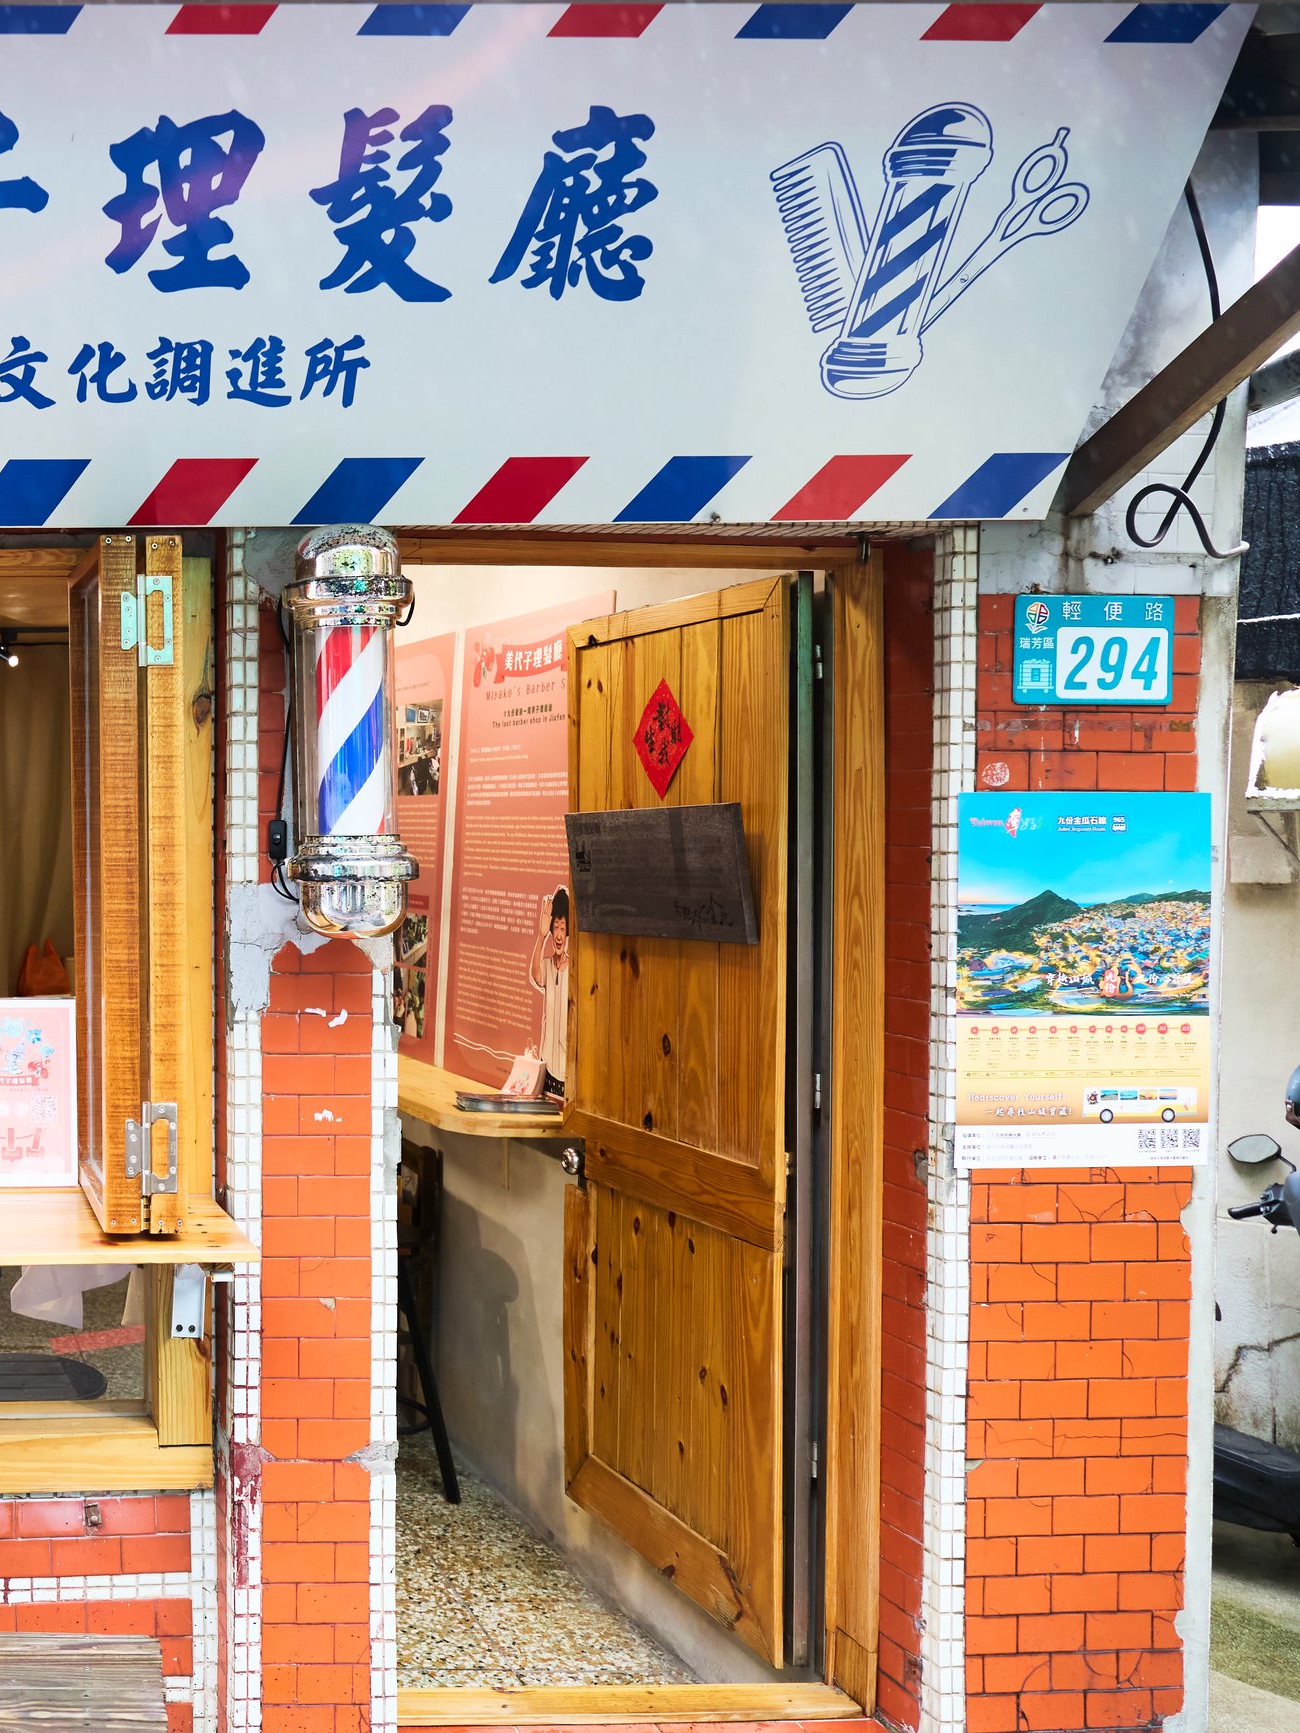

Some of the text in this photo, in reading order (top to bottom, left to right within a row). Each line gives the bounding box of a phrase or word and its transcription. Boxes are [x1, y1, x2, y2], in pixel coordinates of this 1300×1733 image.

[1062, 601, 1164, 621] 輕便路
[1019, 637, 1055, 650] 瑞芳區
[504, 639, 563, 672] 美代子理髮廳
[1063, 635, 1162, 691] 294
[526, 681, 555, 696] Barber
